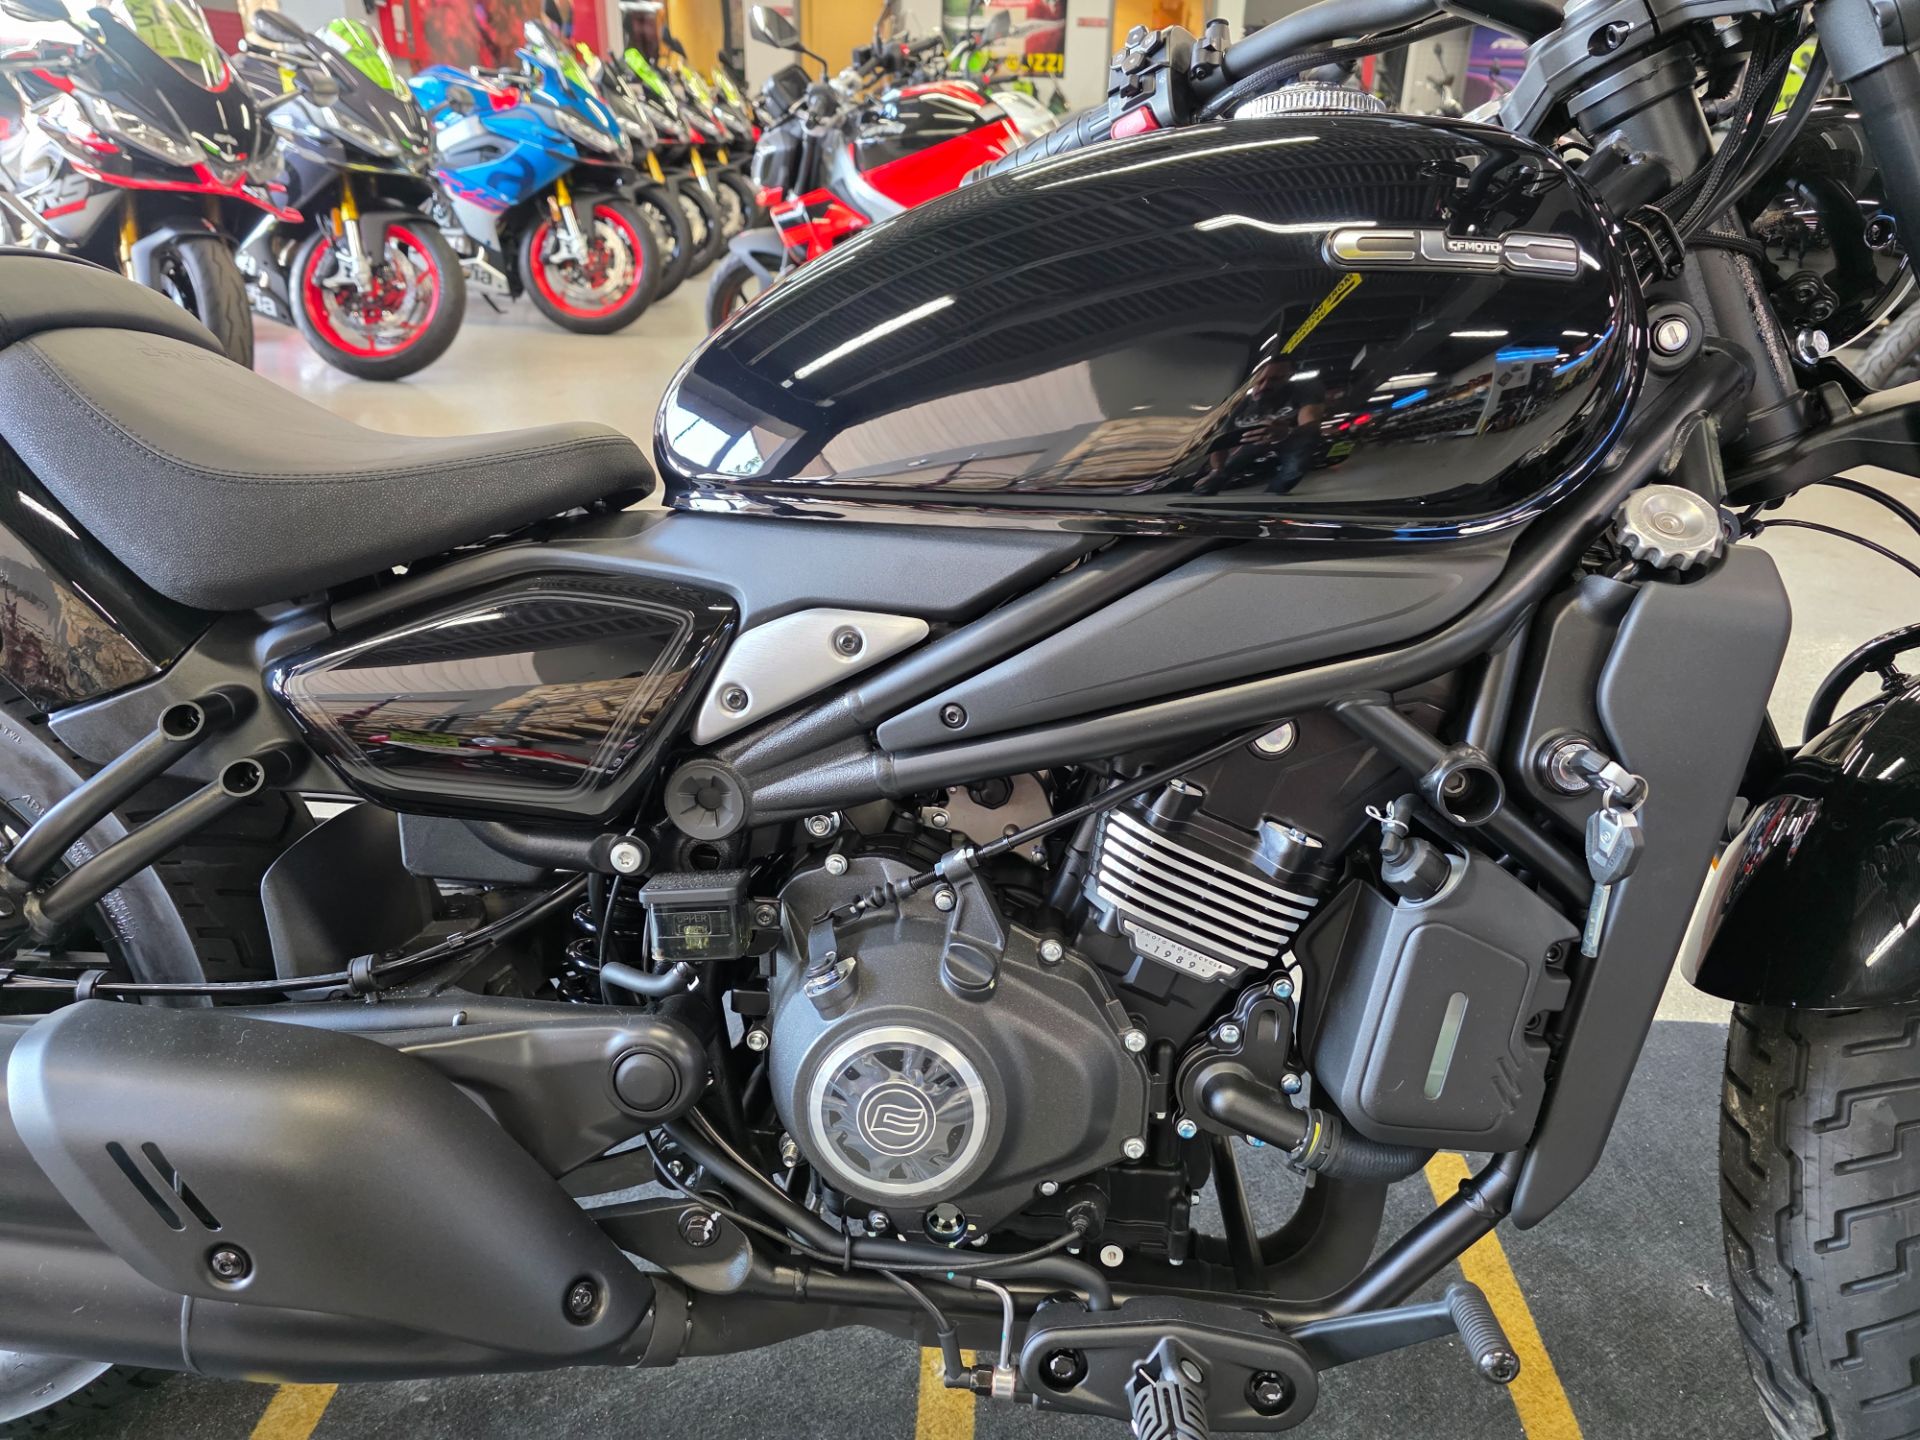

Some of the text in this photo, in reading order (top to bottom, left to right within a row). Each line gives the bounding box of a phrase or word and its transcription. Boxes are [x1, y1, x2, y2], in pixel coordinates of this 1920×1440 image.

[1449, 239, 1502, 252] CFMOTO
[1153, 945, 1197, 970] 1989
[1171, 943, 1223, 970] MOTORCYCLE
